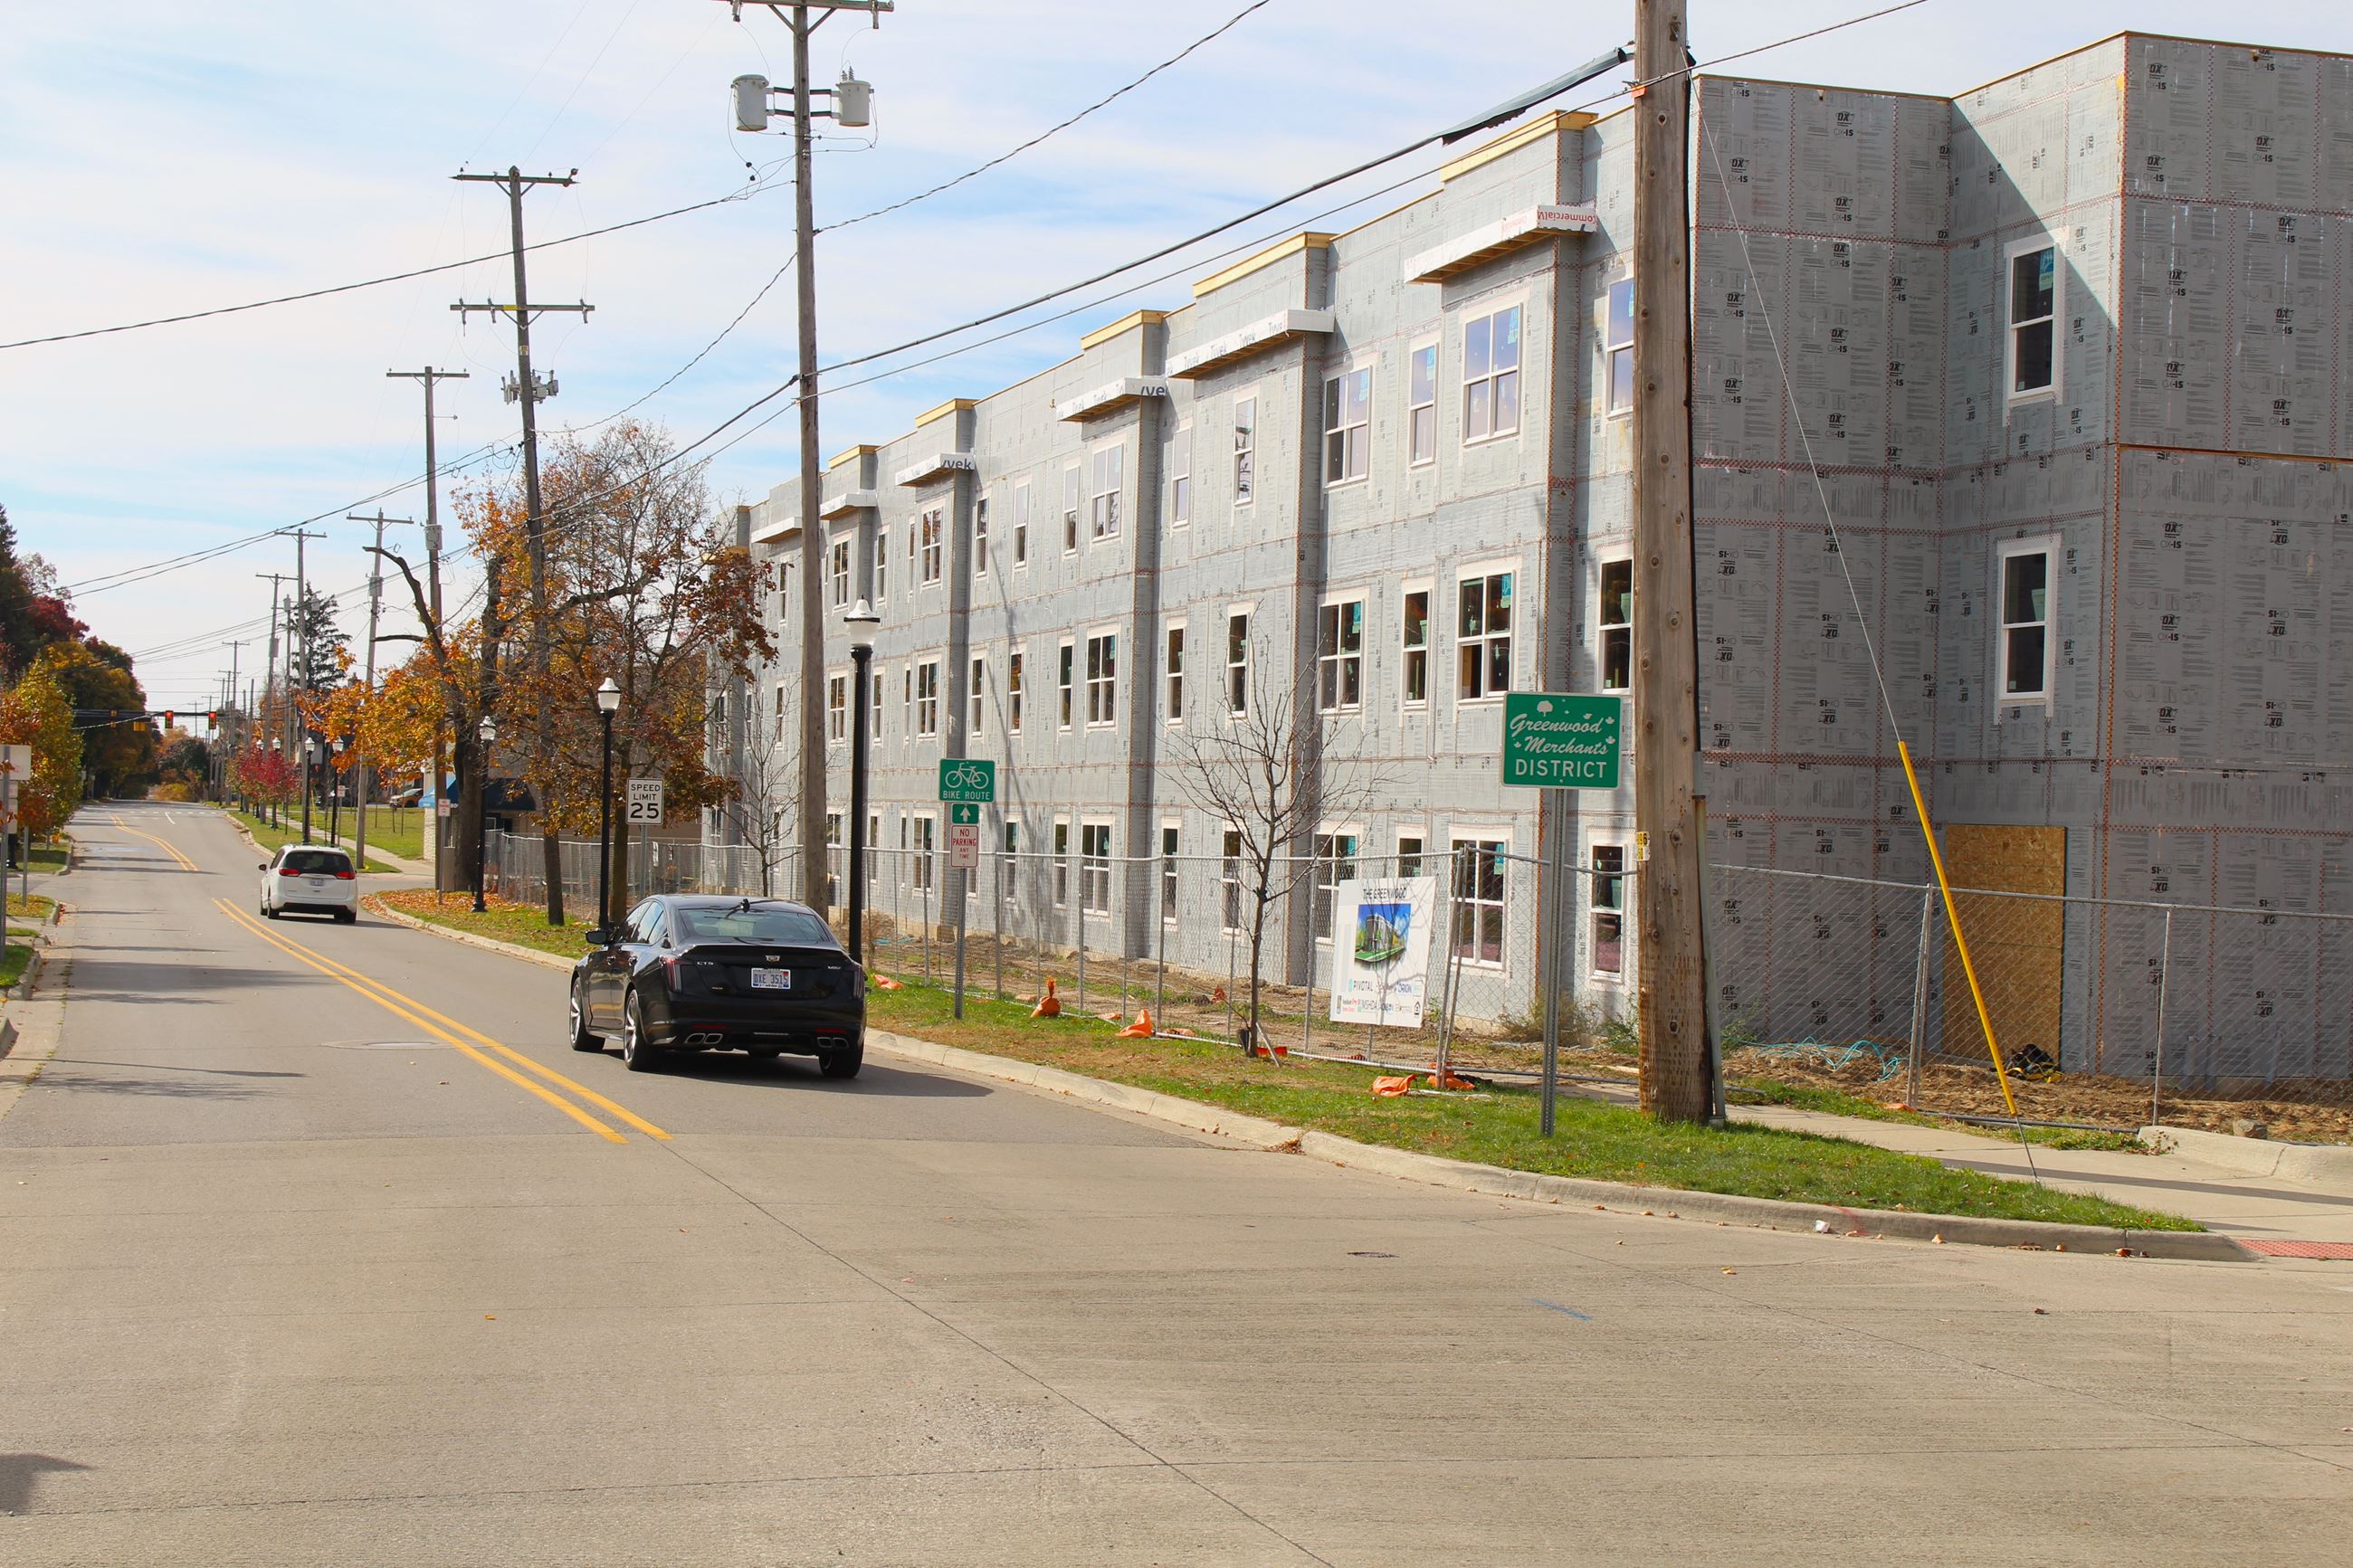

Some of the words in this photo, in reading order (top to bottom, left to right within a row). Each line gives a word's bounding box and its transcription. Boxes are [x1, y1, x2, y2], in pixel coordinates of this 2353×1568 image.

[2149, 63, 2163, 73] OX
[1837, 112, 1851, 121] OX
[2256, 137, 2270, 147] OX
[1731, 158, 1746, 167] OX
[2147, 156, 2161, 166] OX
[1835, 197, 1849, 206] OX
[1833, 243, 1847, 252] OX
[1727, 293, 1740, 302] OX
[1831, 328, 1844, 338] OX
[1725, 379, 1739, 388] OX
[2273, 400, 2287, 410] OX
[1829, 413, 1843, 423] OX
[2164, 523, 2178, 532] OX
[2162, 615, 2175, 625] OX
[2158, 708, 2173, 717] OX
[1510, 713, 1604, 737] Greenwood
[1524, 736, 1608, 755] Merchants
[1515, 758, 1606, 778] DISTRICT
[631, 784, 661, 792] SPEED
[943, 790, 961, 799] BIKE
[965, 791, 990, 801] ROUTE
[630, 803, 659, 819] 25
[959, 829, 969, 837] NO
[952, 838, 976, 847] PARKING
